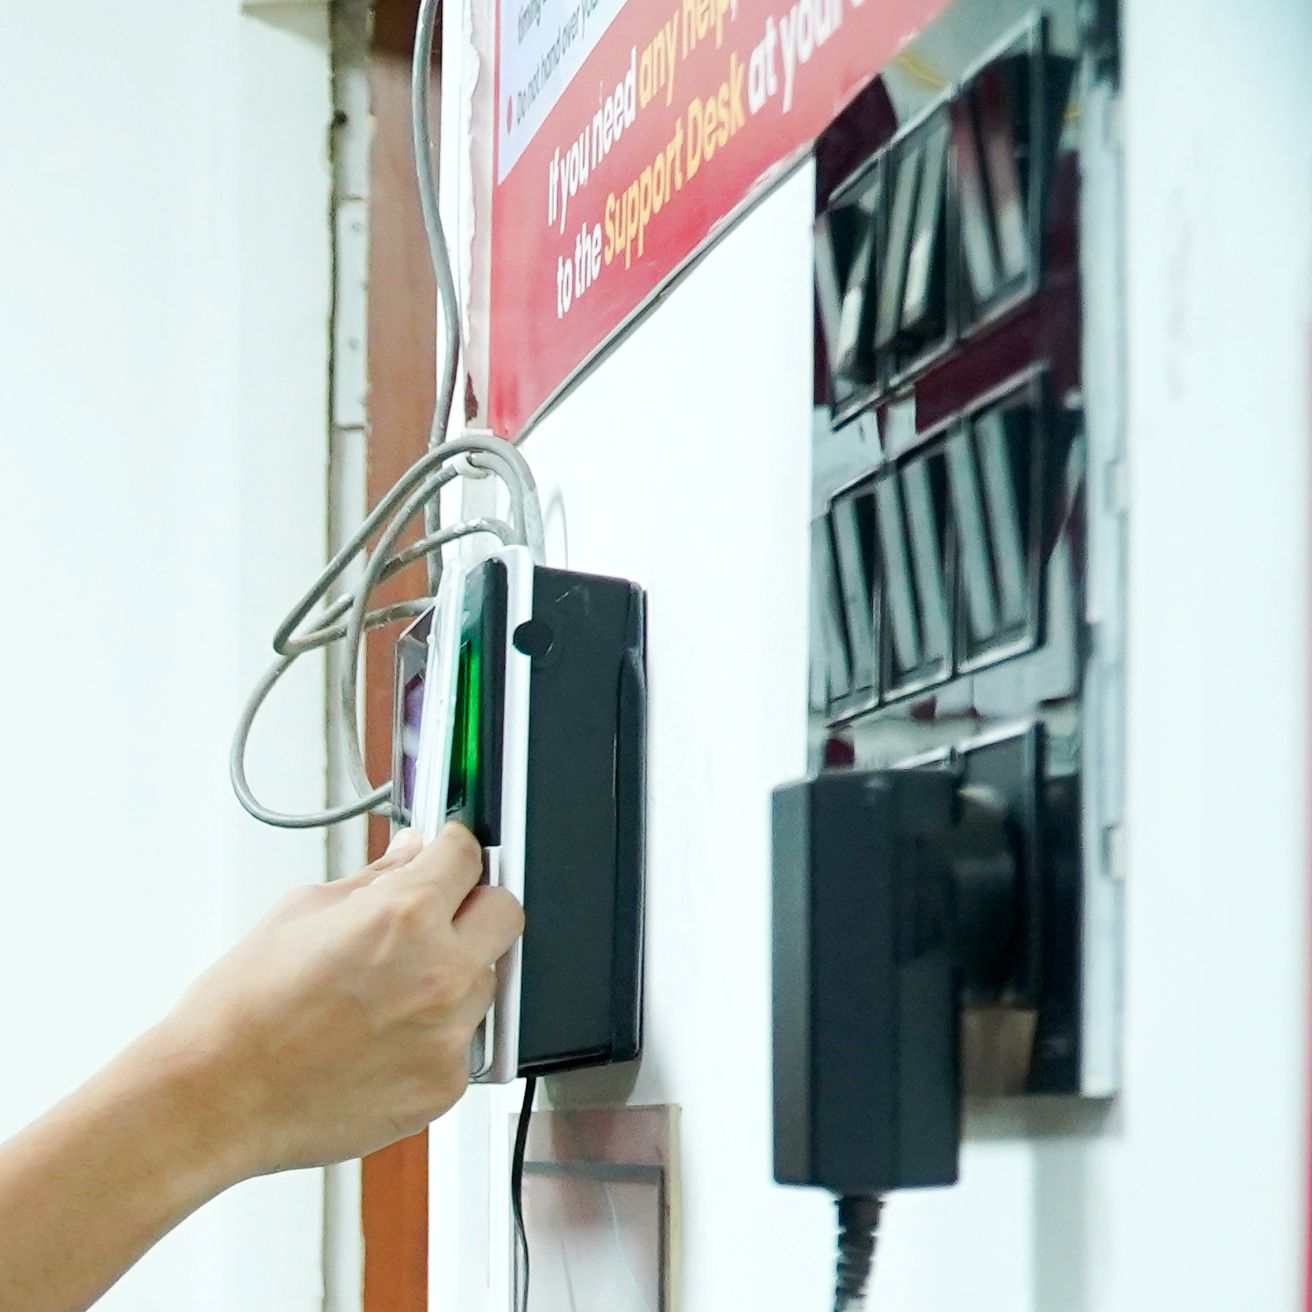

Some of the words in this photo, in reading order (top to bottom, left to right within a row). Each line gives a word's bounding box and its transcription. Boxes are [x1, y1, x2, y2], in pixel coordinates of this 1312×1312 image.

[548, 146, 560, 226] If
[560, 125, 590, 234] you
[592, 46, 637, 170] need
[639, 9, 679, 107] any
[557, 256, 573, 319] to
[575, 221, 602, 299] the
[604, 116, 684, 270] Support
[686, 52, 746, 182] Desk
[748, 14, 777, 116] at
